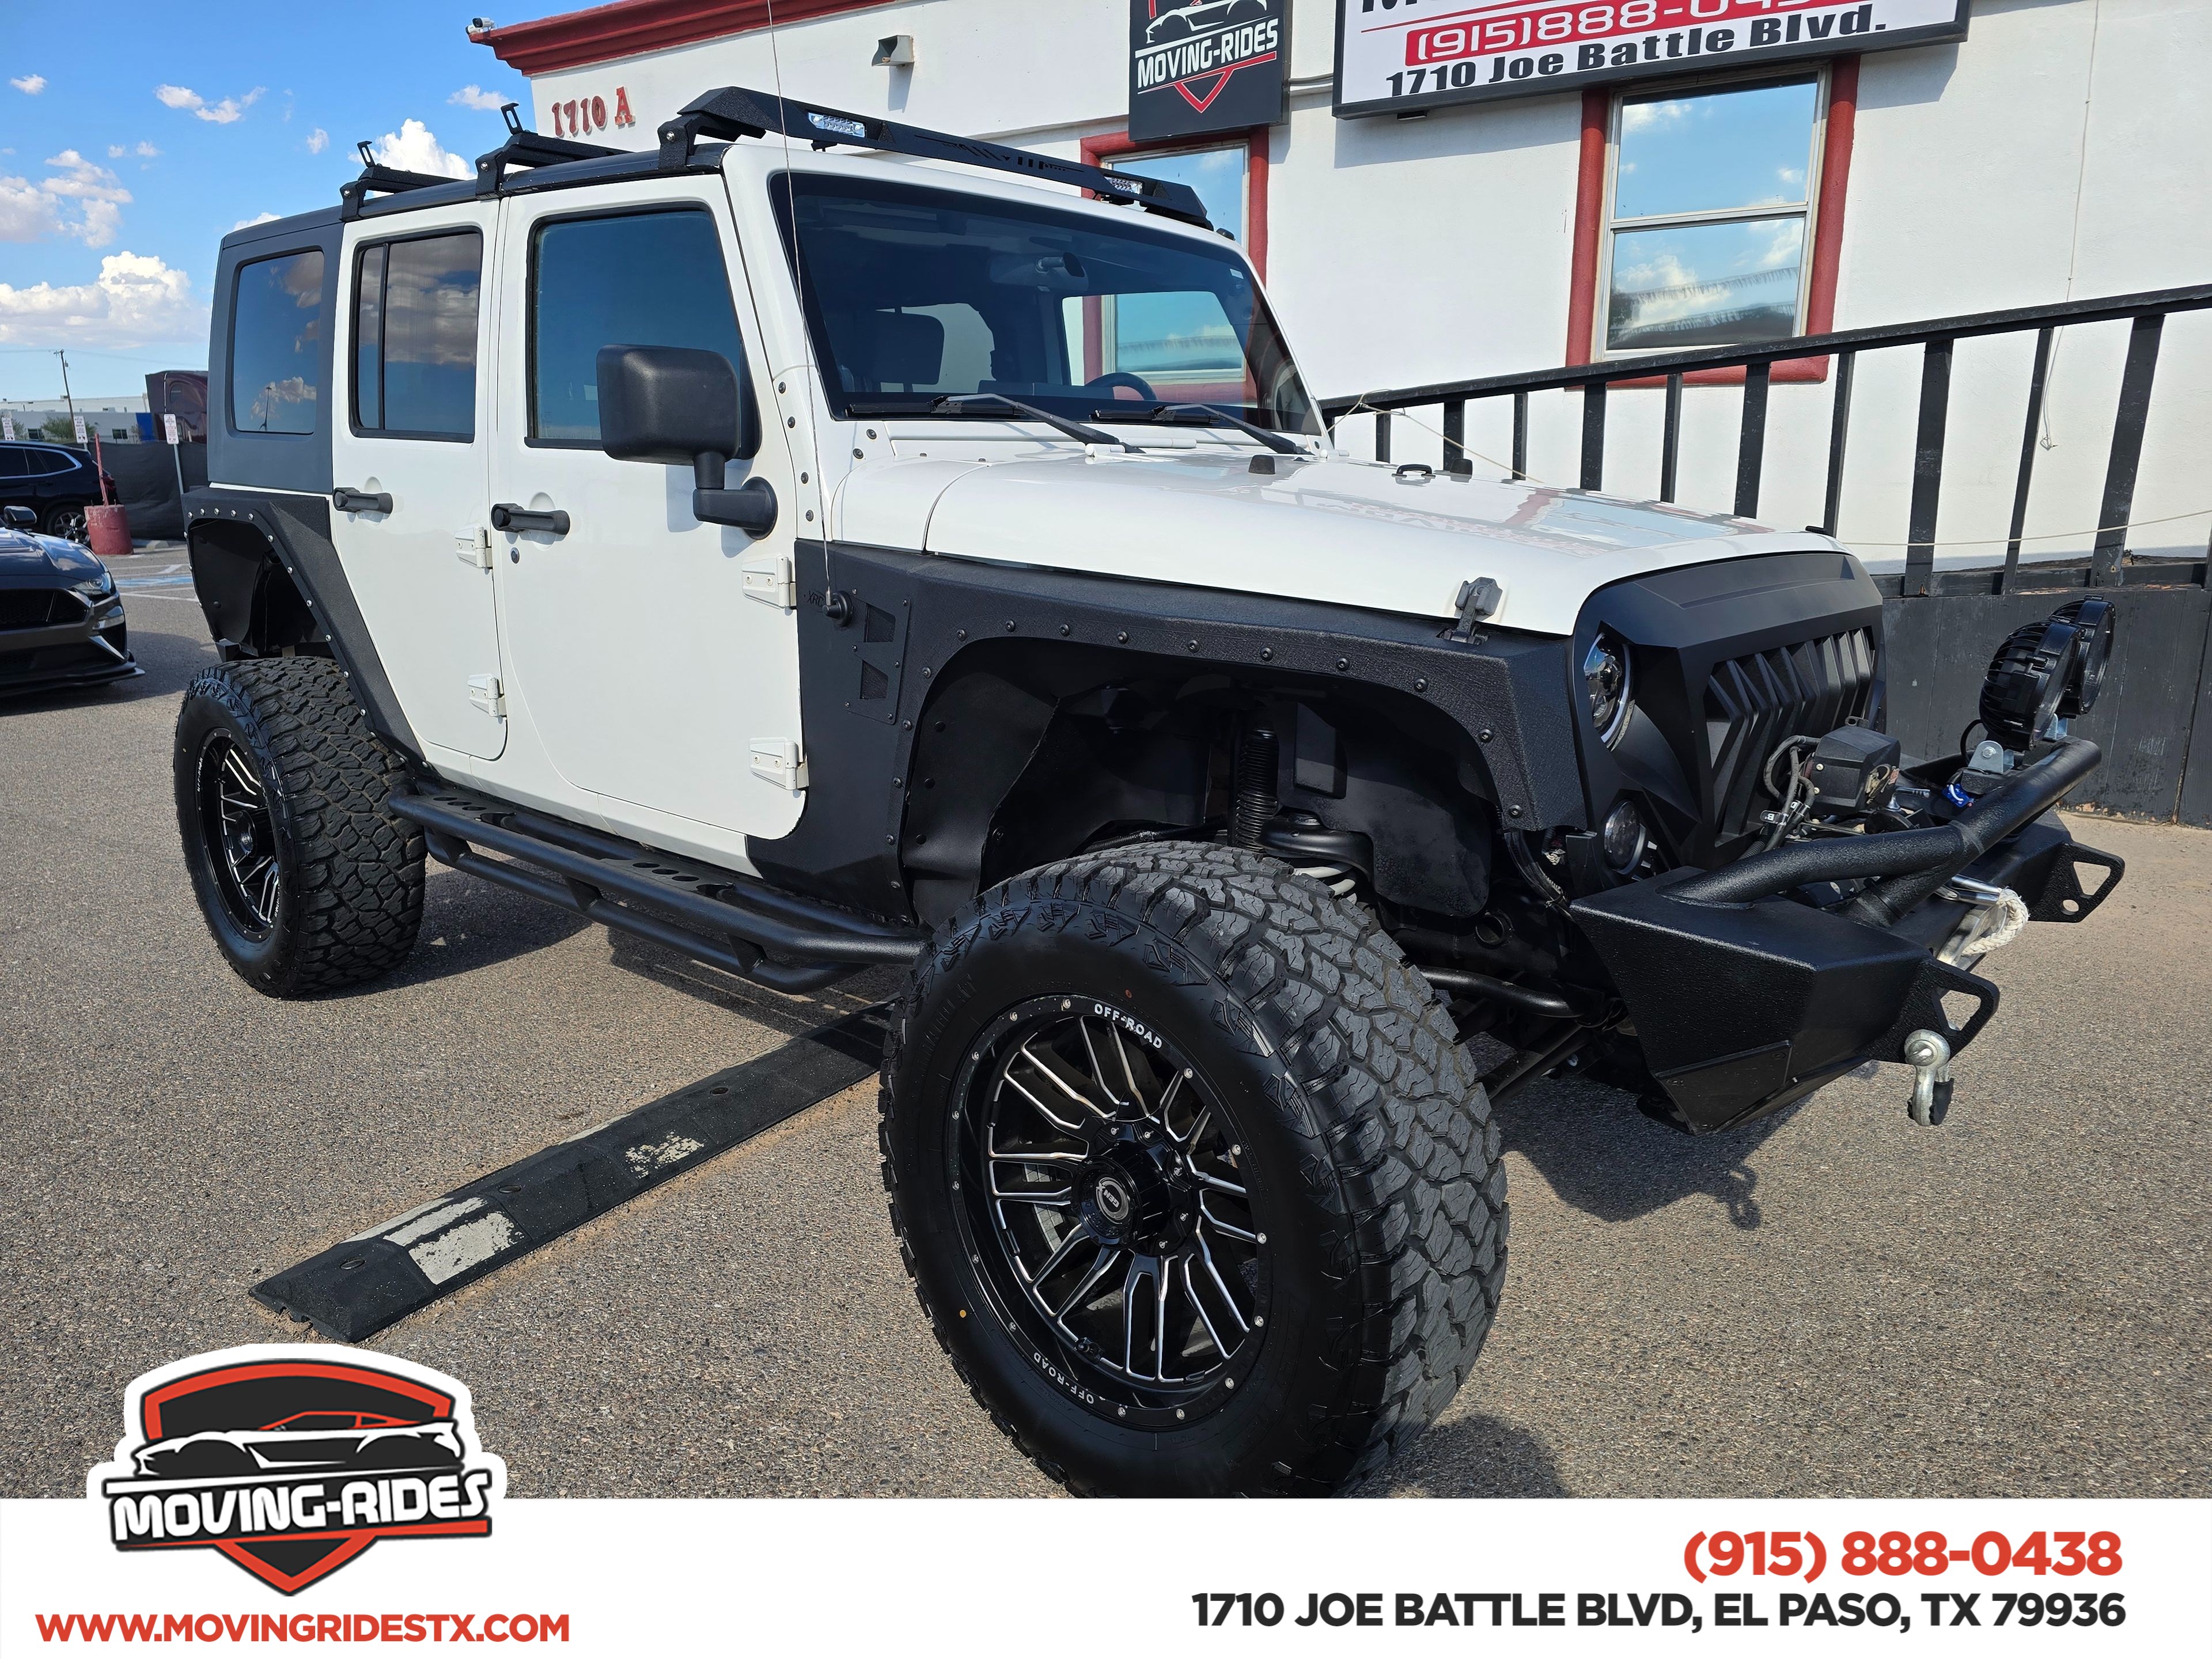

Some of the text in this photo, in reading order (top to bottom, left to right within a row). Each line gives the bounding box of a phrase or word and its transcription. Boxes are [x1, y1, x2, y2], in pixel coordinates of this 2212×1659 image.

[1138, 18, 1278, 88] MOVING-RIDES
[1386, 3, 1887, 97] 1710 Joe Battle Blvd.
[551, 86, 635, 137] 1710 A
[1094, 1003, 1162, 1048] OFF-ROAD
[1033, 1352, 1094, 1404] OFF-ROAD
